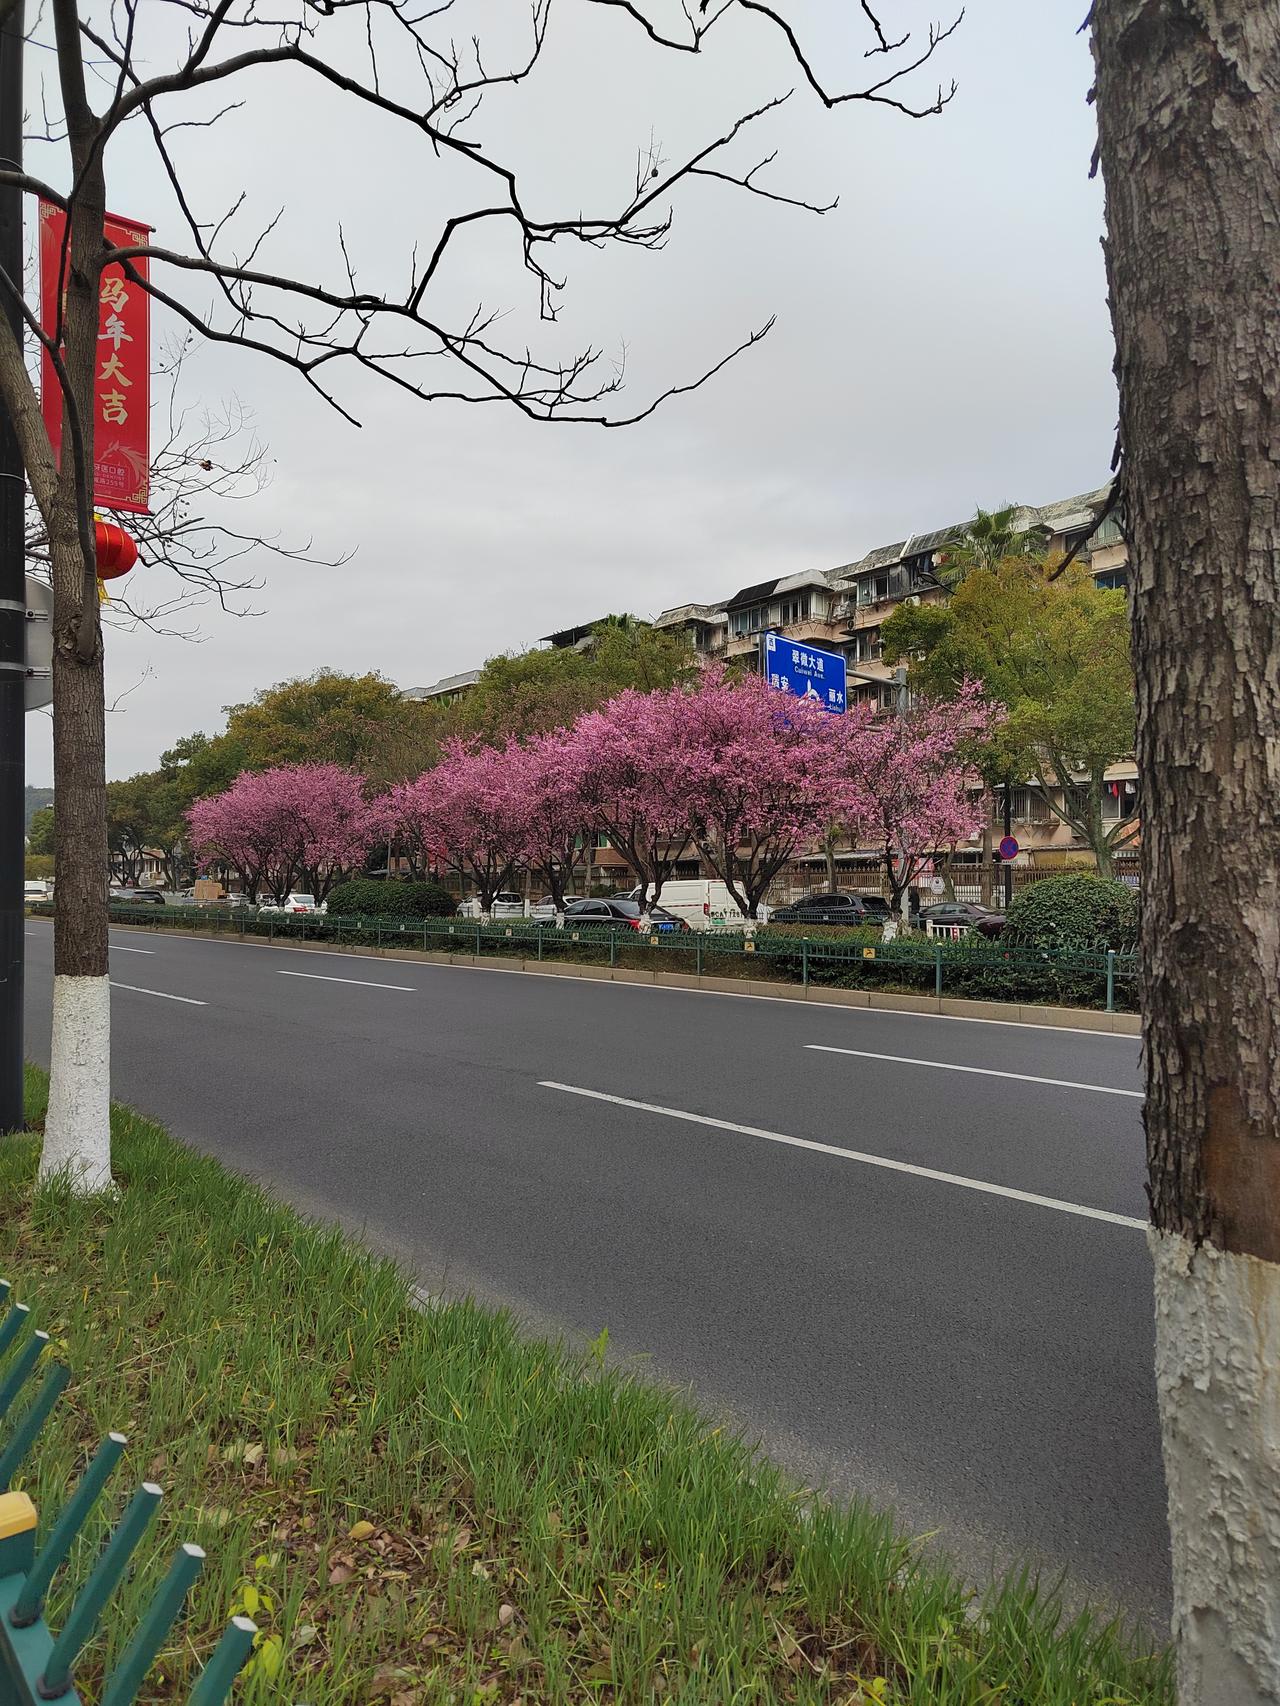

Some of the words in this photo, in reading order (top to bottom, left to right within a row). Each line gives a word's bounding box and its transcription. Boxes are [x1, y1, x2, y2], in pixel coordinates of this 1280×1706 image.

[98, 277, 133, 425] 马年大吉
[792, 650, 824, 672] 翠微大道
[794, 665, 813, 676] Cuiwei
[828, 688, 844, 704] 丽水
